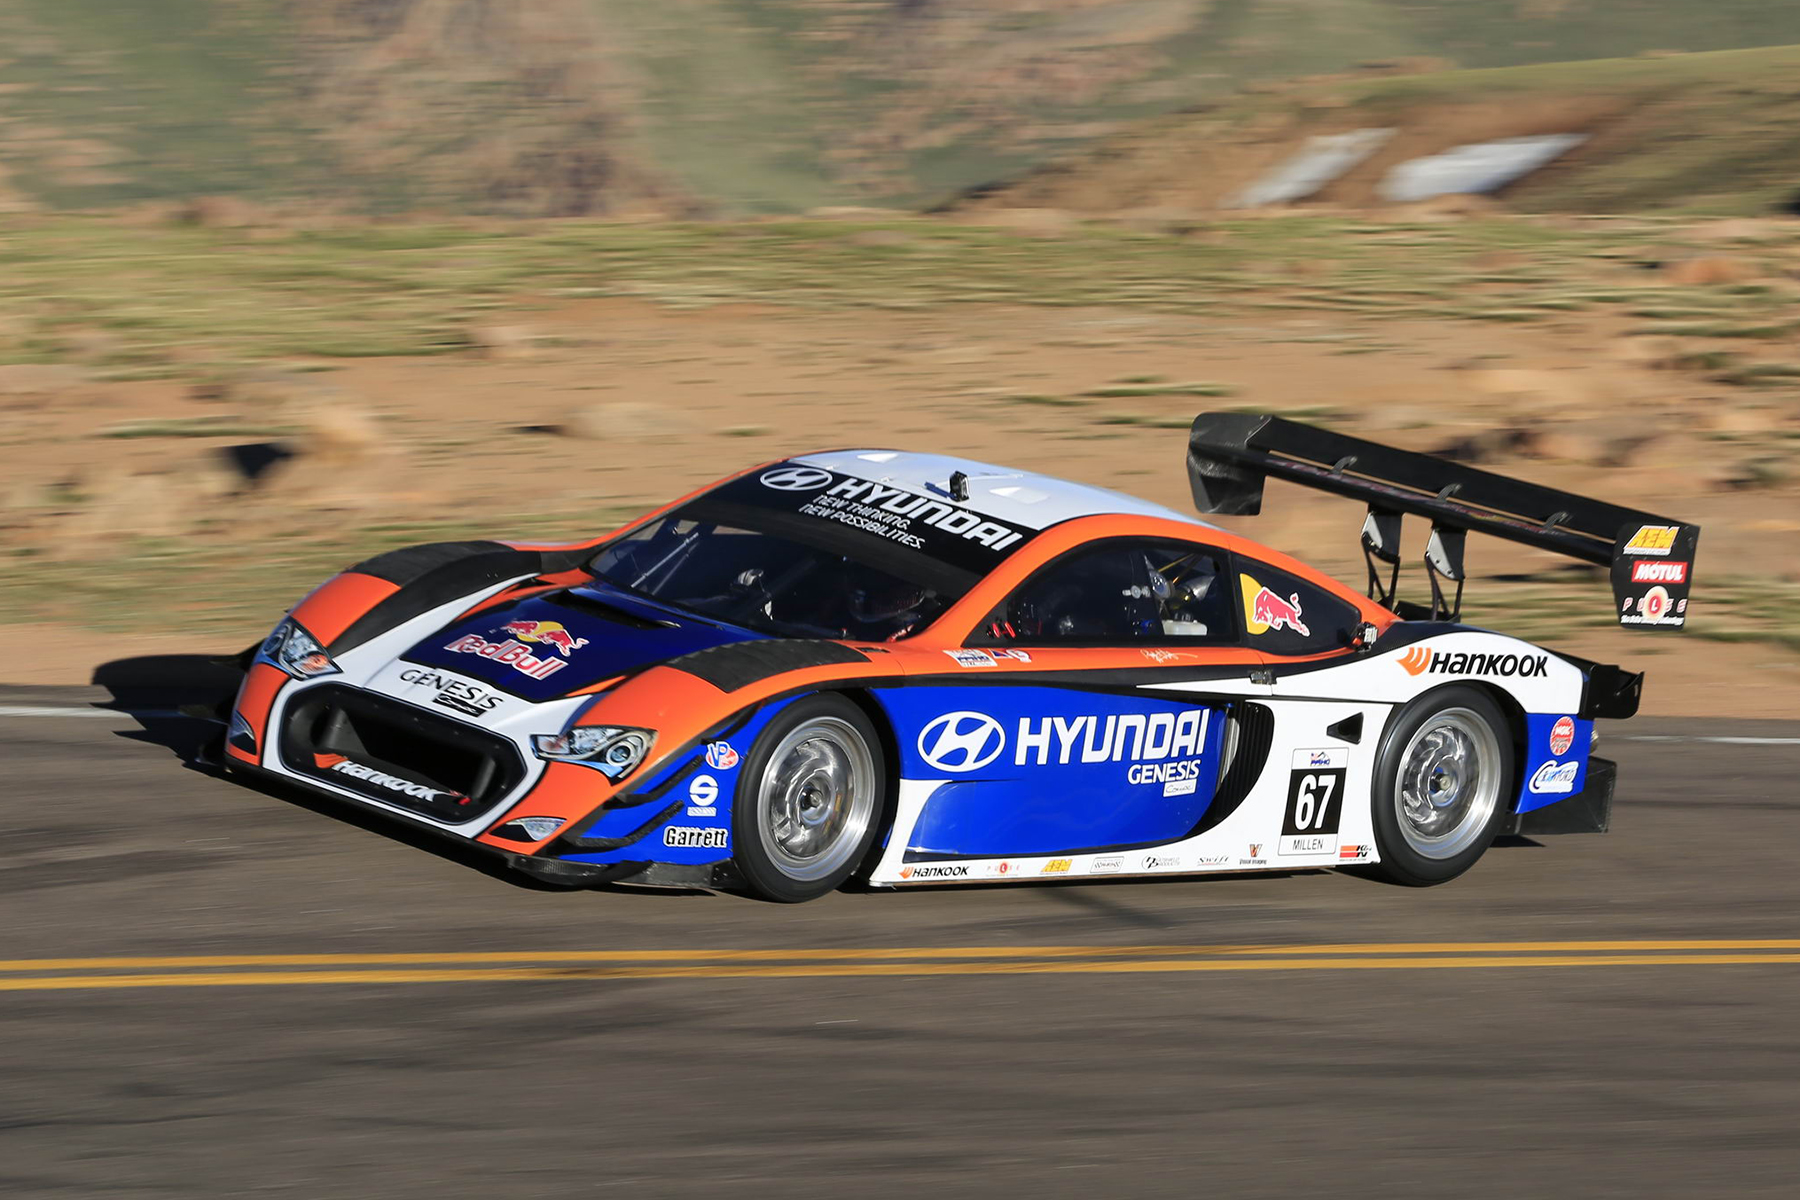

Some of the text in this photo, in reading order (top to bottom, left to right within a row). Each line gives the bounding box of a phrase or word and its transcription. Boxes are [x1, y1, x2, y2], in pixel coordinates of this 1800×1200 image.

[799, 503, 835, 517] NEW
[813, 494, 849, 509] NEW
[826, 478, 1023, 551] HYUNDAI
[1626, 527, 1679, 549] AEM
[1635, 562, 1683, 580] MOTUL
[400, 668, 503, 710] GENESIS
[1014, 708, 1210, 766] HYUNDAI
[707, 742, 729, 768] VP
[1127, 759, 1201, 785] GENESIS
[1295, 774, 1336, 830] 67
[665, 827, 727, 847] Garrett
[1293, 839, 1324, 850] MILLEN
